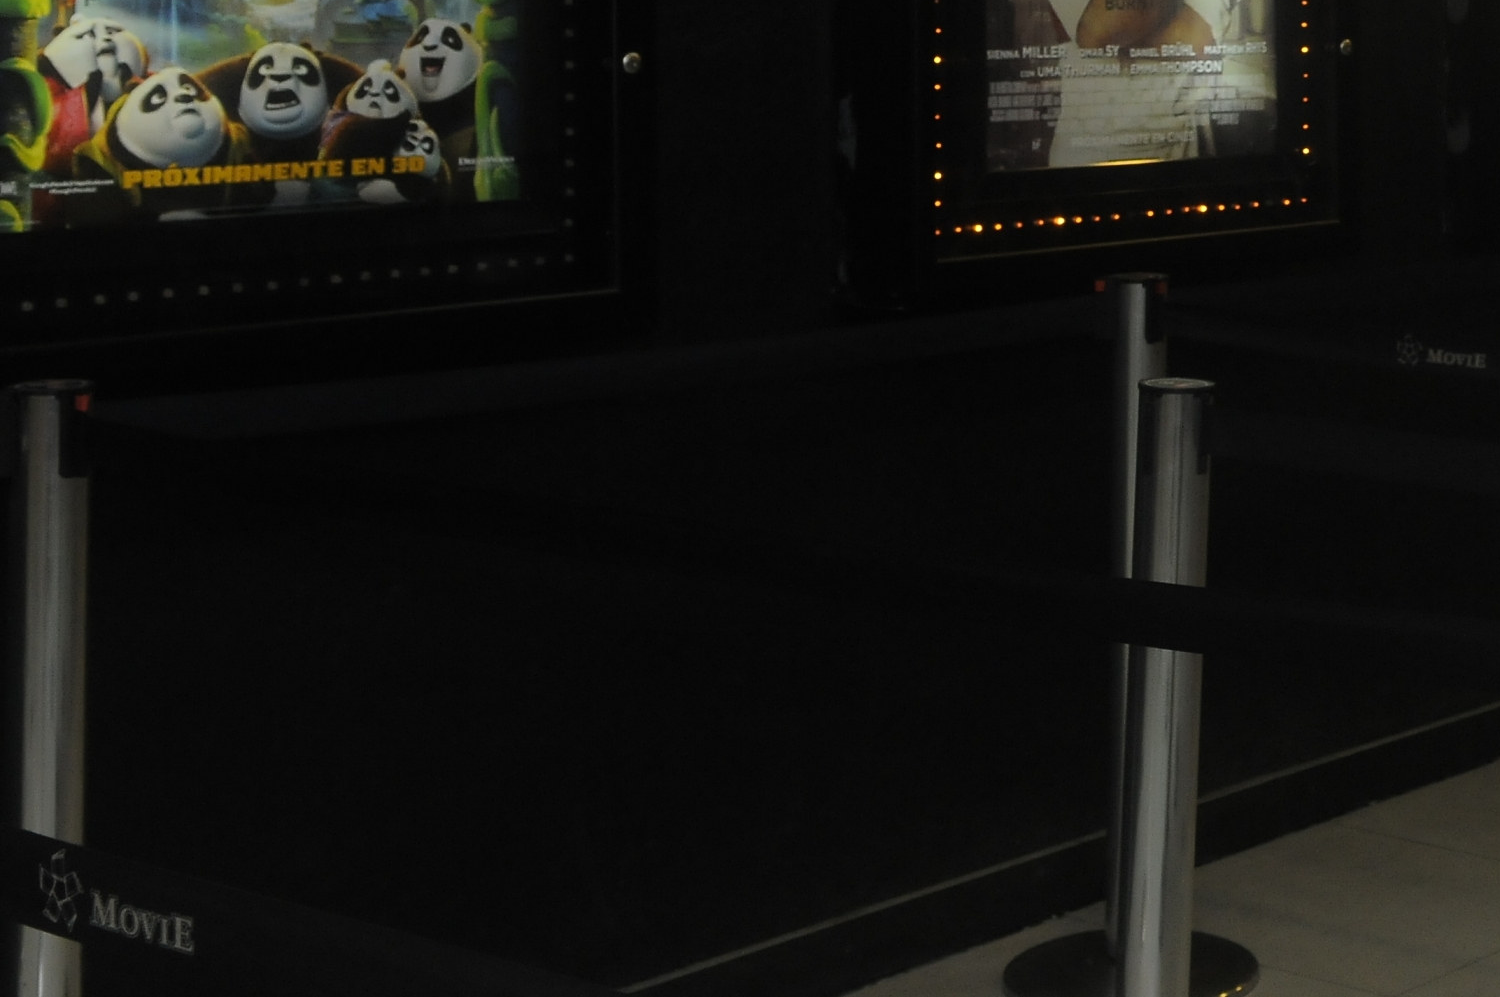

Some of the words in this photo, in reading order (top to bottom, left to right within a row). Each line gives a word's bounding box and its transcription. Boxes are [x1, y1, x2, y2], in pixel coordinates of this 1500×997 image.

[122, 160, 344, 189] PRÓXIMAMENTE
[351, 158, 386, 176] EN
[392, 156, 426, 174] 3D
[1425, 347, 1487, 369] MOVIE
[90, 888, 195, 955] MOVIE
